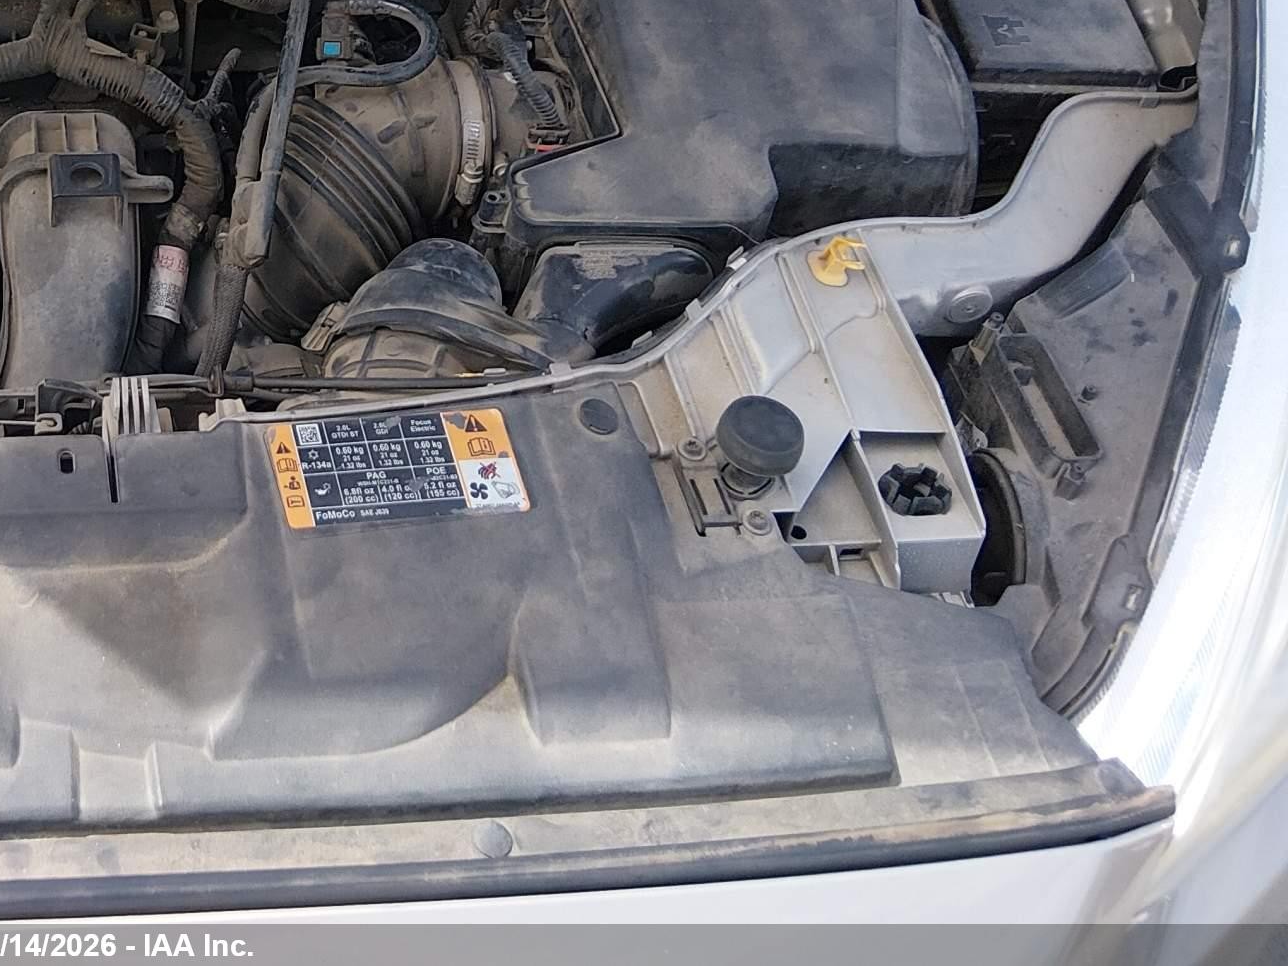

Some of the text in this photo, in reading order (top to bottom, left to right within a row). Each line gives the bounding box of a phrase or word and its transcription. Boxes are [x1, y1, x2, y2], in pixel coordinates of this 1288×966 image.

[373, 442, 401, 452] 0.60 kg
[414, 440, 442, 450] 0.60 kg
[335, 446, 364, 455] 0.60 kg
[302, 461, 332, 470] R-134a
[366, 471, 386, 480] PAG
[426, 467, 447, 475] POE
[382, 485, 394, 494] 4.0
[424, 482, 436, 490] 5.2
[385, 492, 418, 502] (120 cc)
[426, 489, 460, 499] (155 cc)
[345, 494, 378, 504] (200 cc)
[315, 509, 355, 520] FoMoCo
